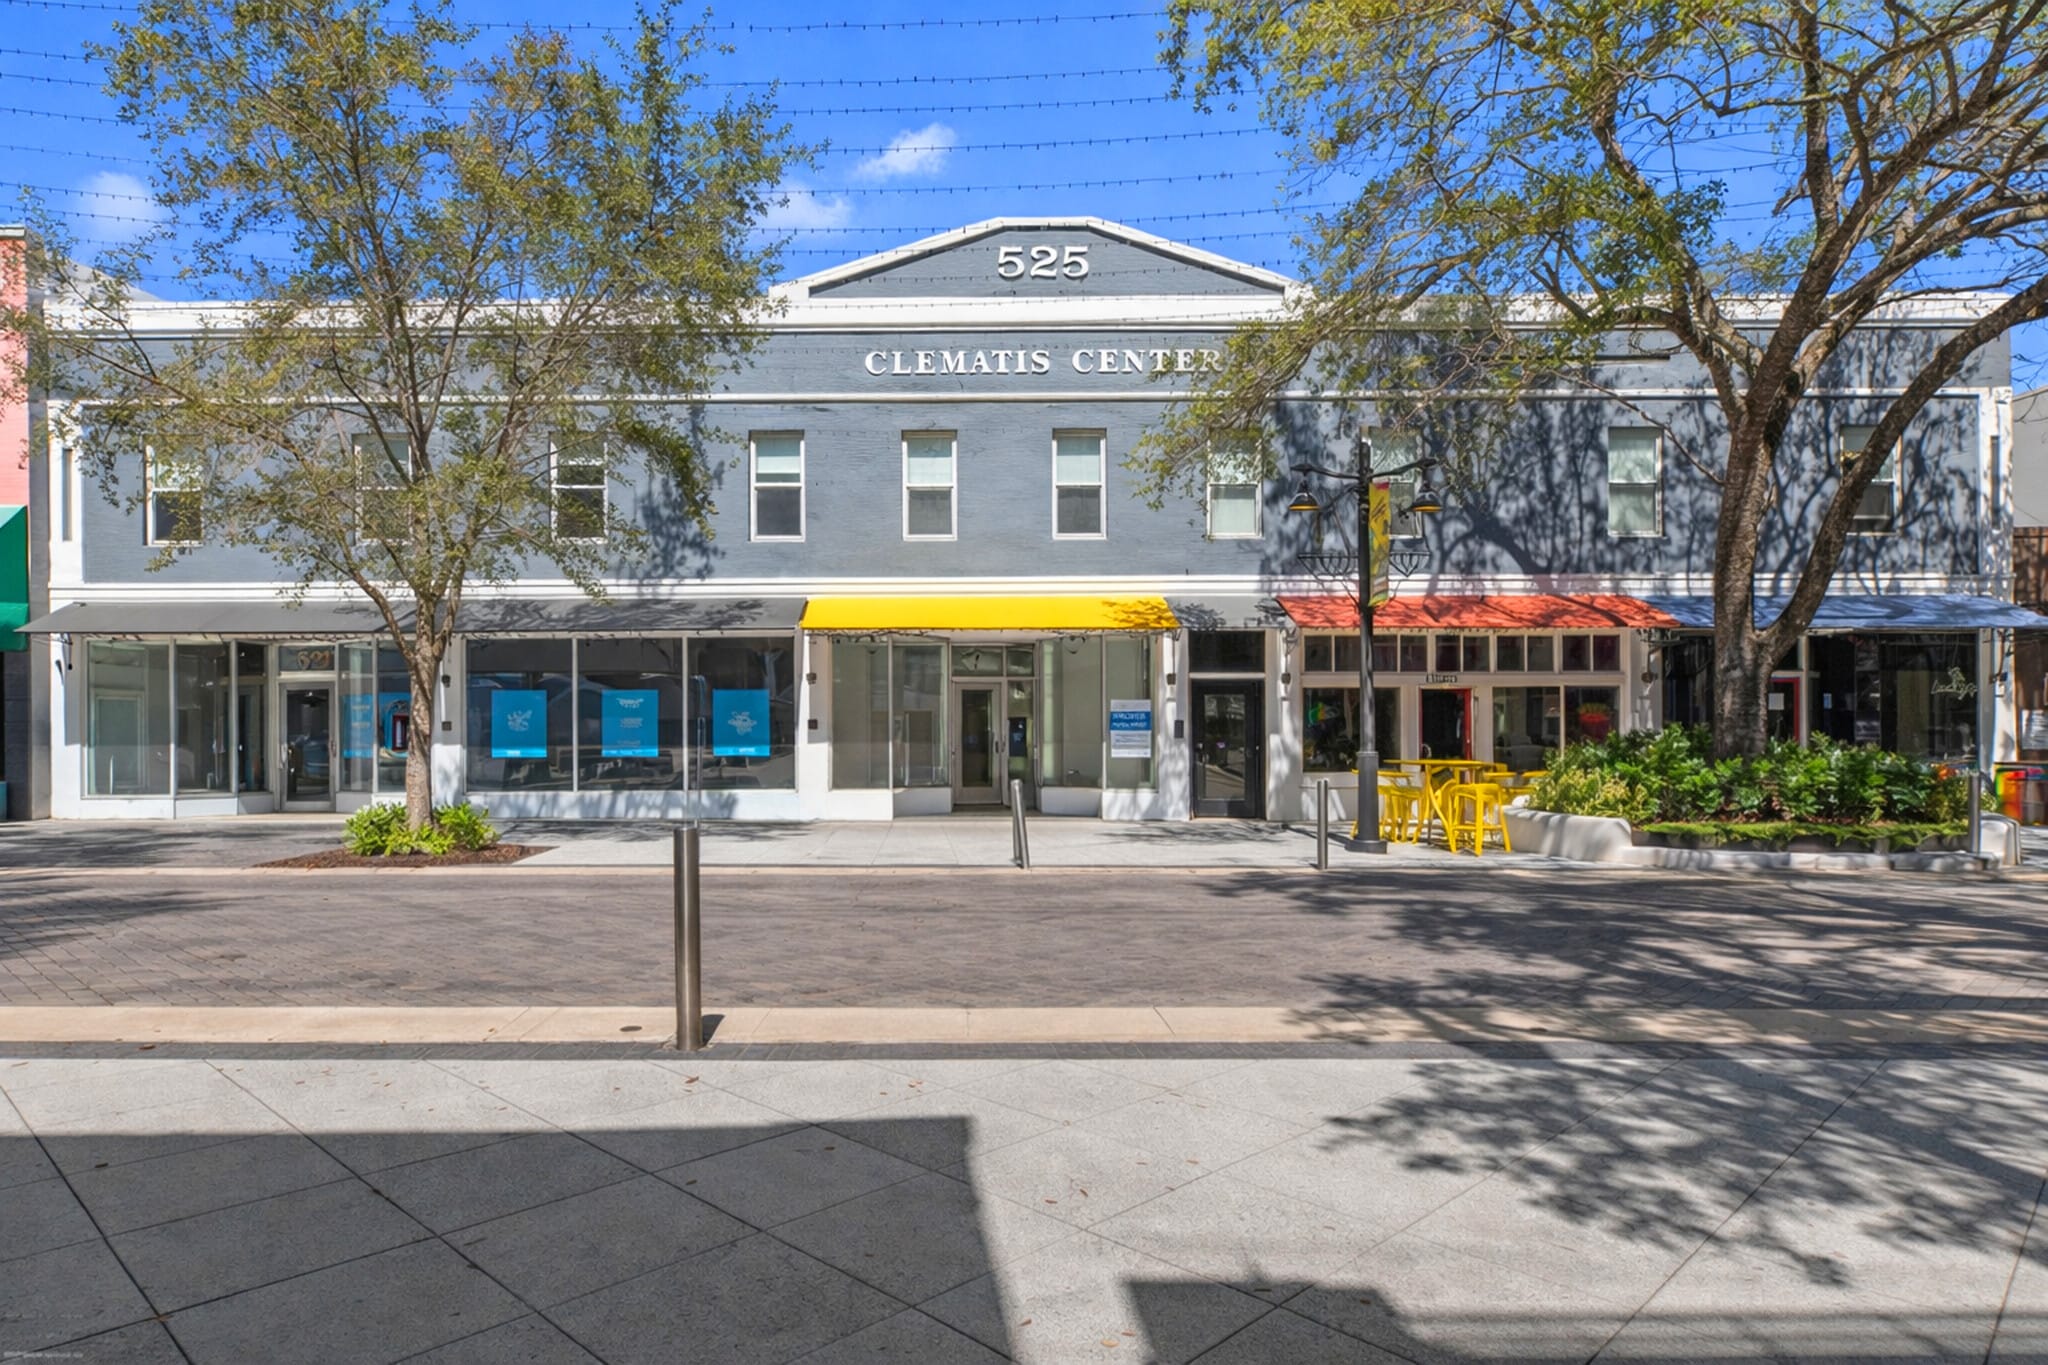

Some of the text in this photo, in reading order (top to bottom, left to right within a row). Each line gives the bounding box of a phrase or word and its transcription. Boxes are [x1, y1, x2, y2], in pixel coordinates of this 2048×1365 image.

[997, 245, 1090, 279] 525
[864, 348, 1223, 376] CLEMATIS CENTER
